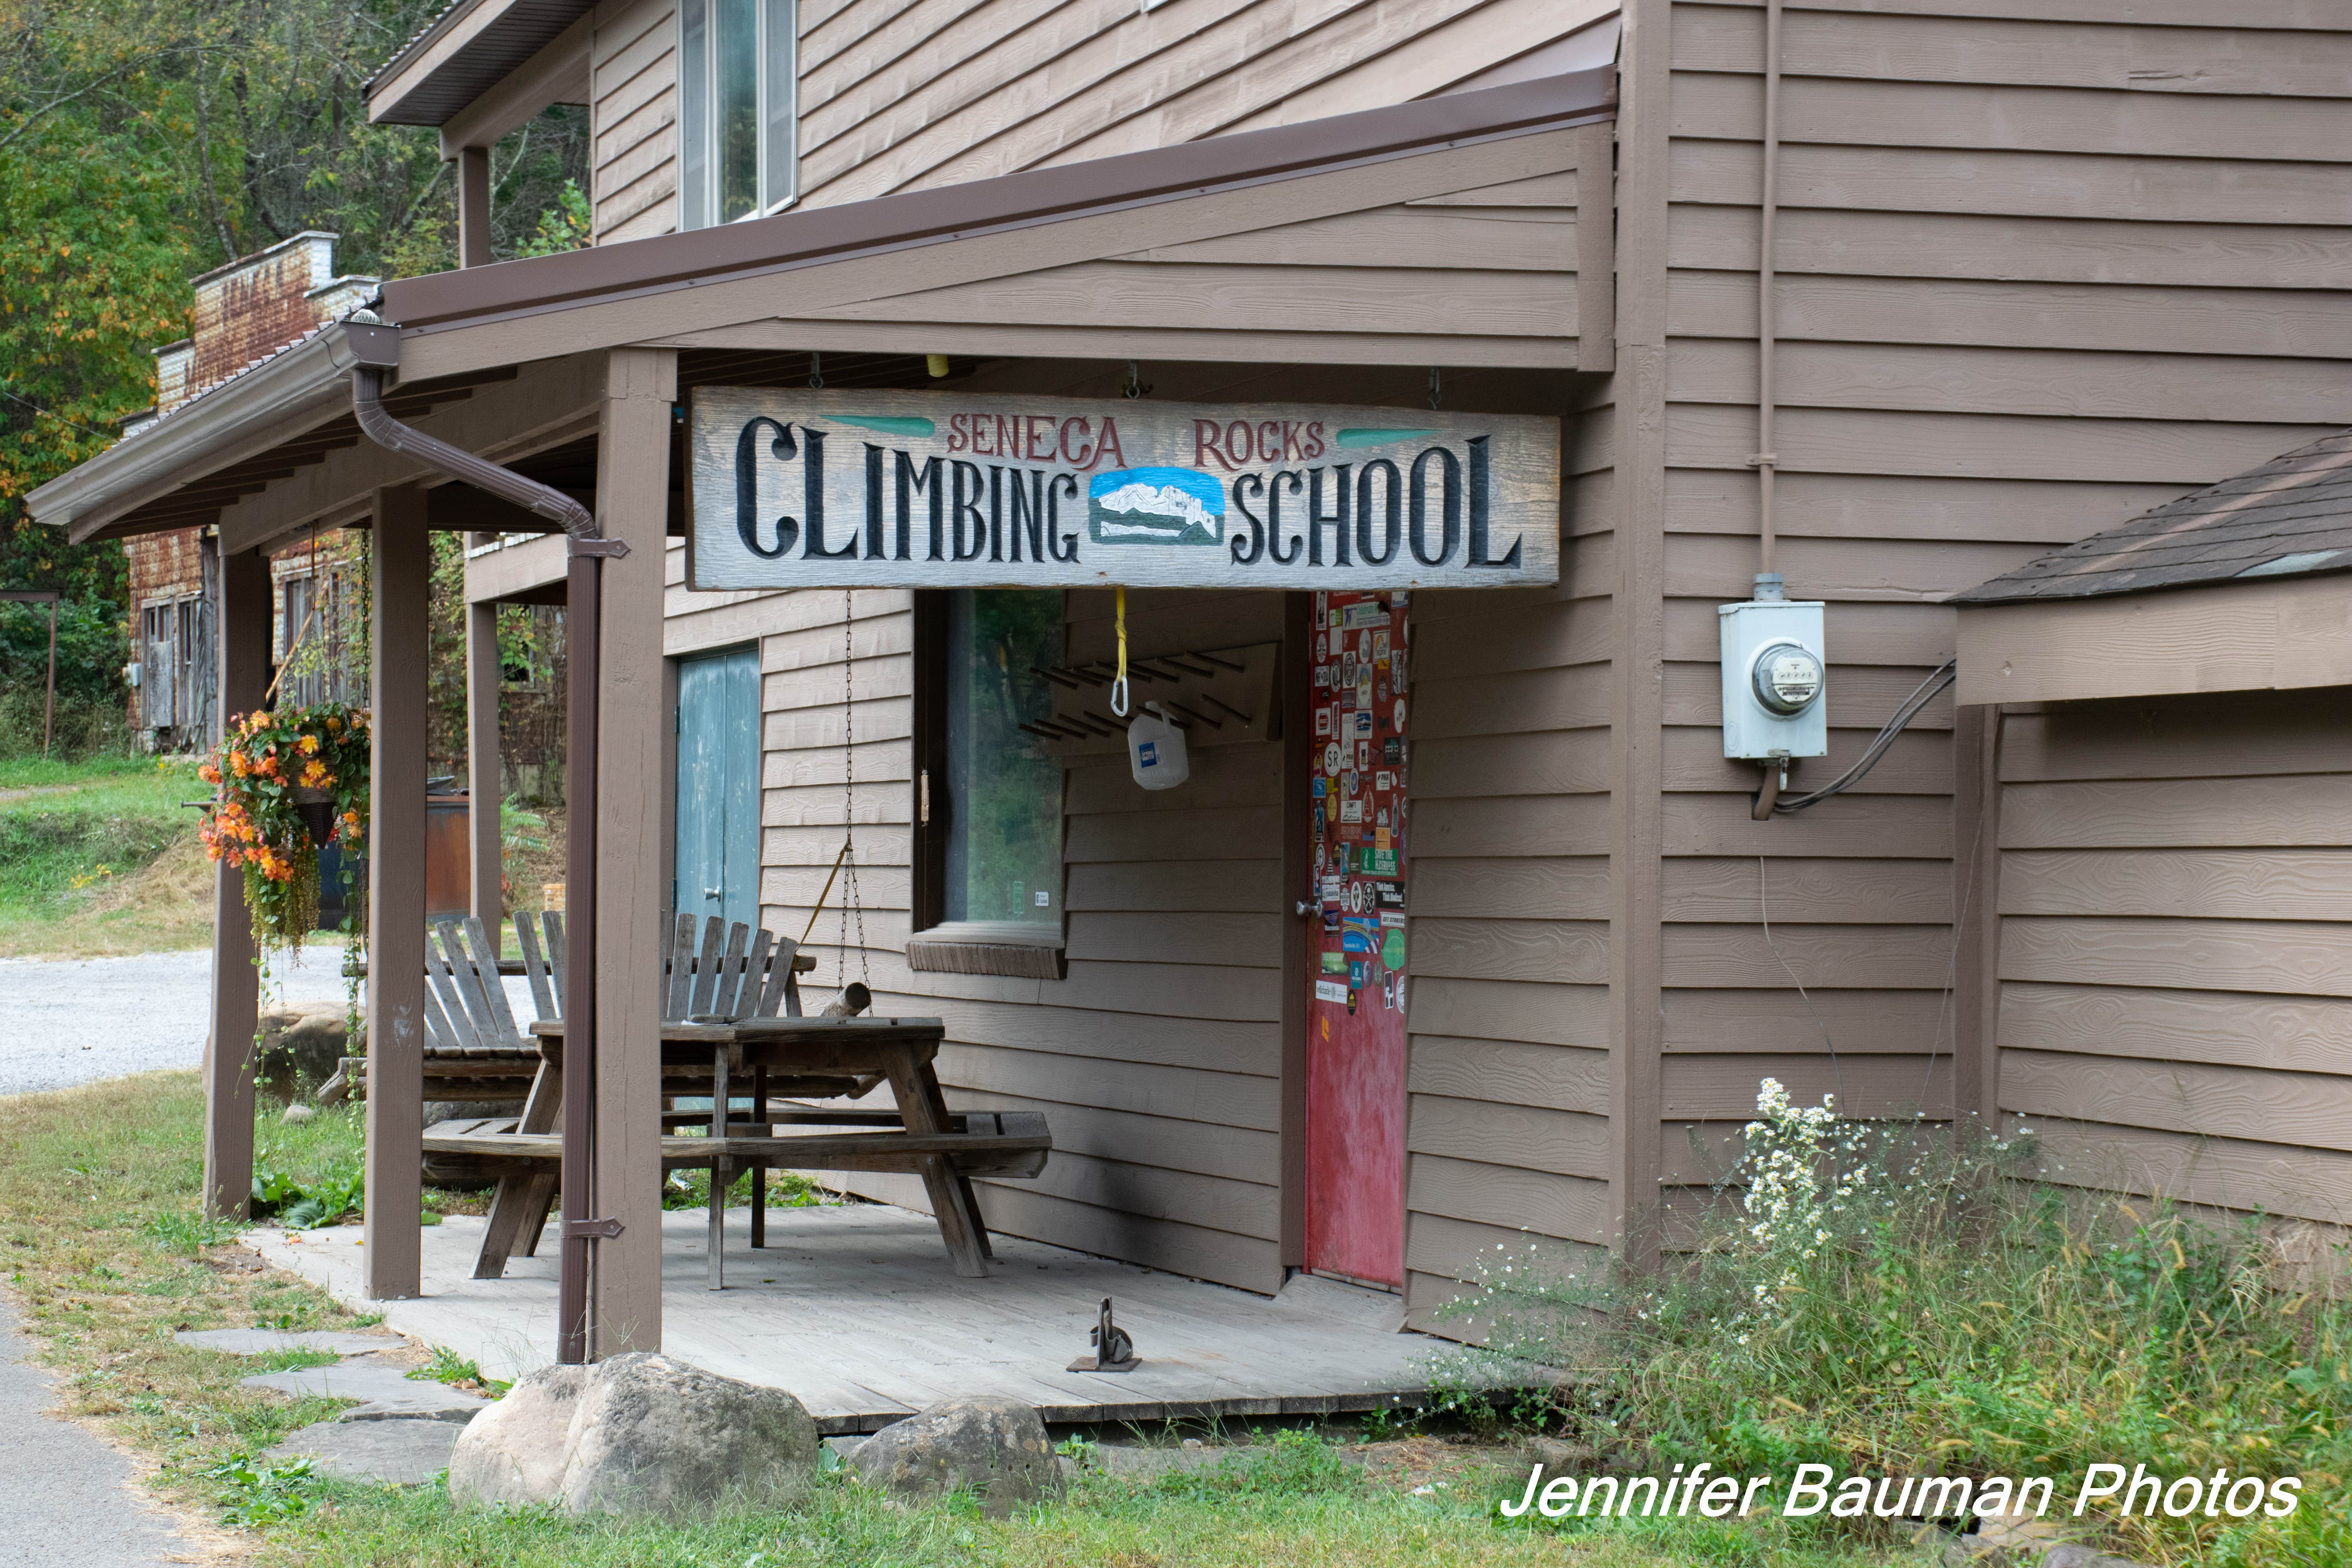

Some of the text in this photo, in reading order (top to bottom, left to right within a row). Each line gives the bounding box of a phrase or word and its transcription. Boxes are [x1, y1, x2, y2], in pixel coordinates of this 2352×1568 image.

[947, 413, 1325, 472] SENECA ROCKS
[735, 415, 1523, 570] CLIMBING SCHOOL
[1327, 751, 1339, 767] SR
